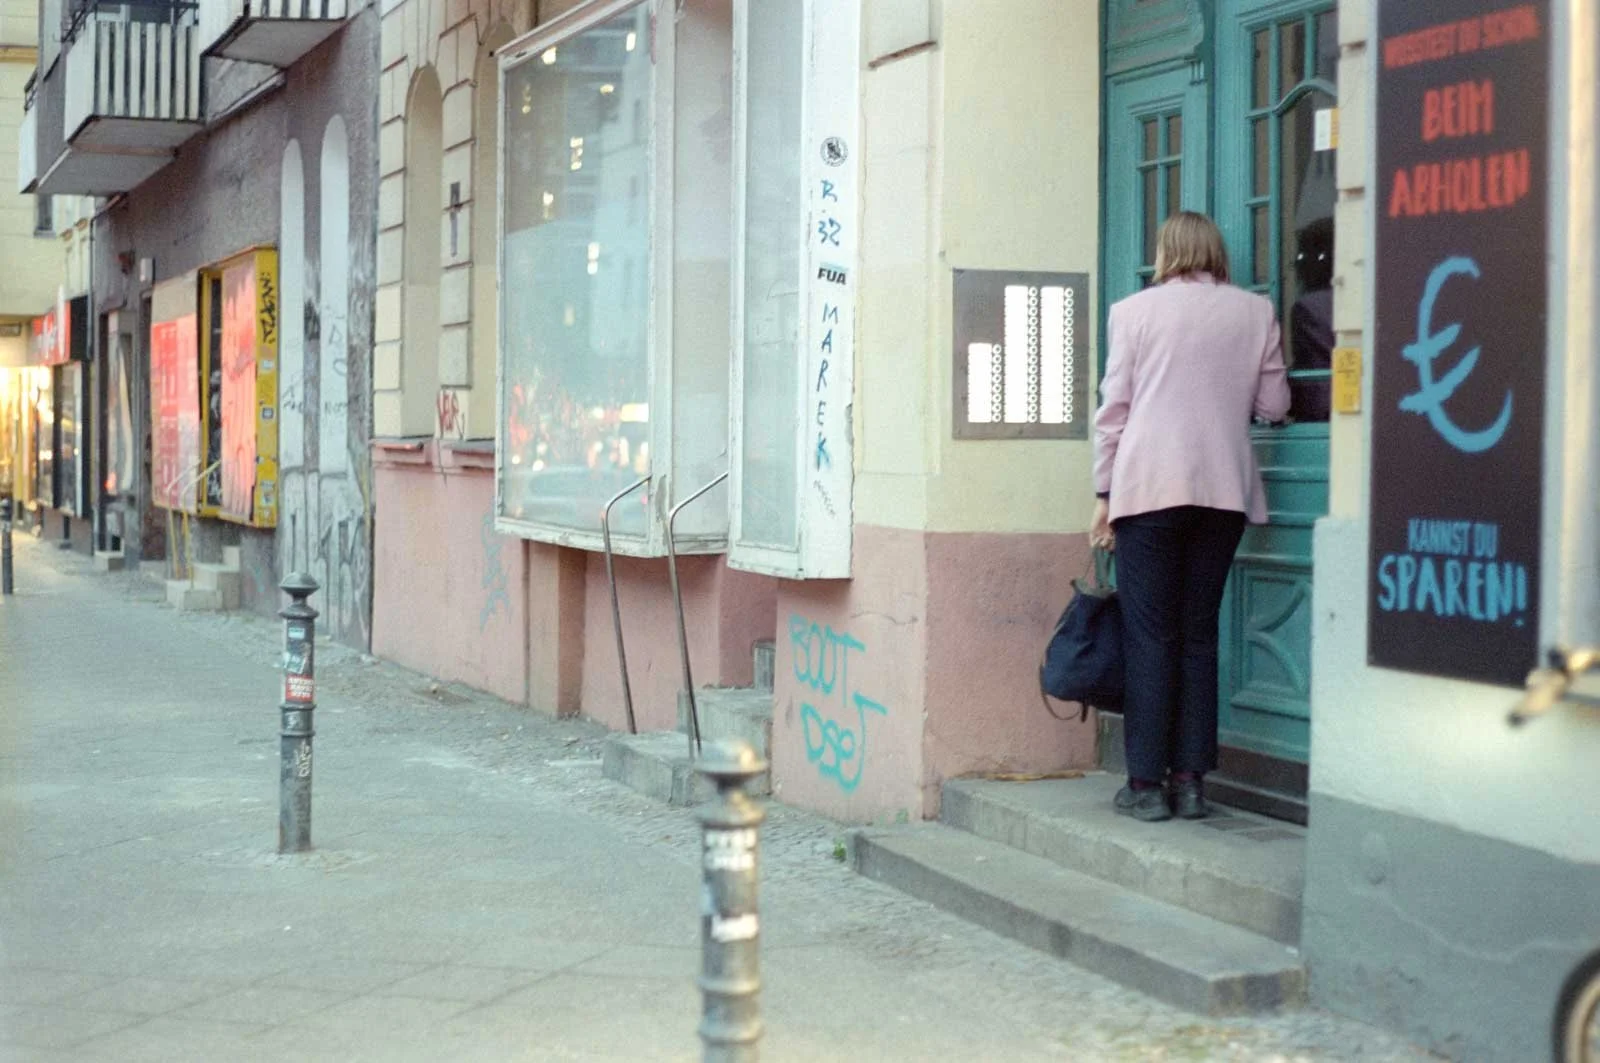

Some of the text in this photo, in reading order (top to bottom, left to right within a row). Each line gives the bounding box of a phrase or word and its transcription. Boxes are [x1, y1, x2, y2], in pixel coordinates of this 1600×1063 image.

[1421, 79, 1494, 142] BEIM
[1388, 148, 1531, 218] ABHOLEN
[817, 267, 847, 285] FUA
[1397, 256, 1513, 453] €
[1408, 518, 1498, 558] KANNST DU
[1377, 554, 1527, 628] SPAREN!
